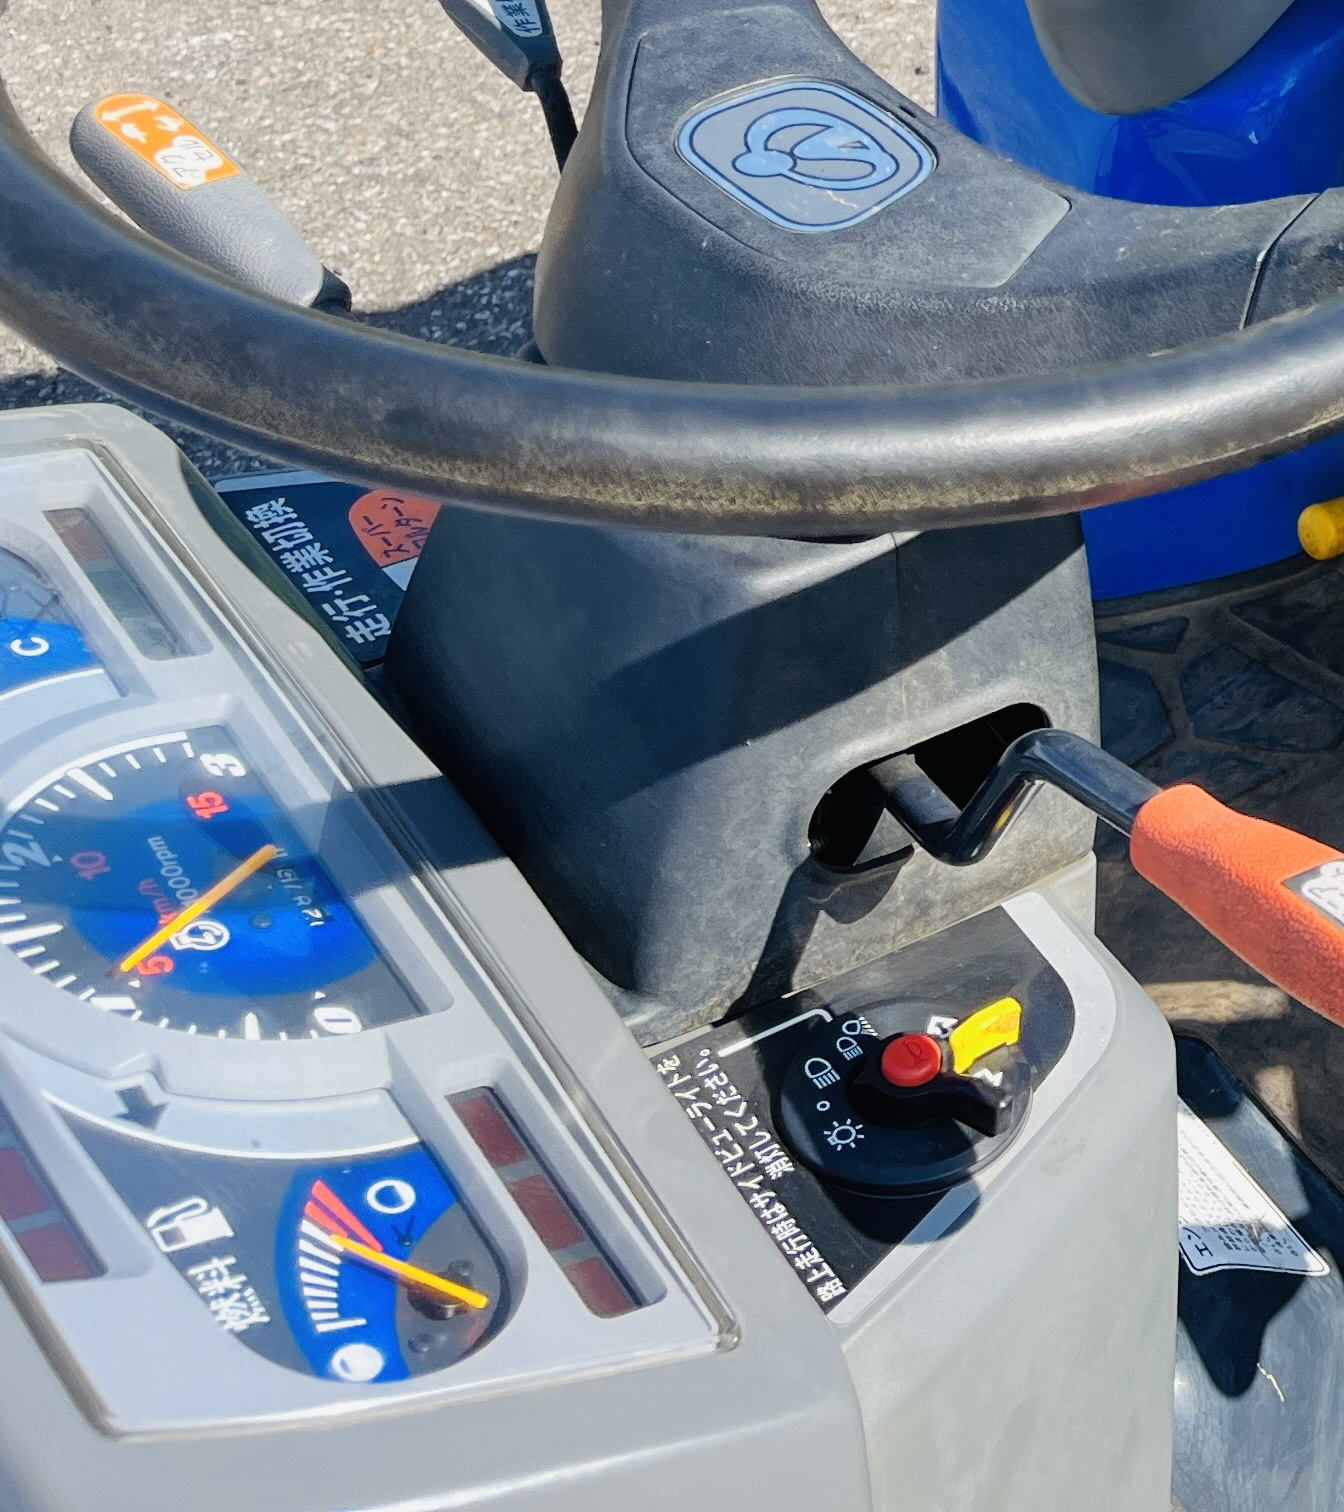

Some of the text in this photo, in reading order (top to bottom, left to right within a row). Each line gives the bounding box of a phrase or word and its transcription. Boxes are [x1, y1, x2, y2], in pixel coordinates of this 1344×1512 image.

[362, 516, 410, 558] スーパー
[10, 635, 50, 657] C
[199, 753, 246, 777] 3
[187, 792, 230, 818] 15
[70, 851, 112, 879] 10
[136, 956, 174, 976] 5
[696, 1048, 795, 1181] 消灯してください。
[656, 1054, 847, 1302] 路上走行時はサイドビューライトを
[188, 1254, 271, 1333] 燃料
